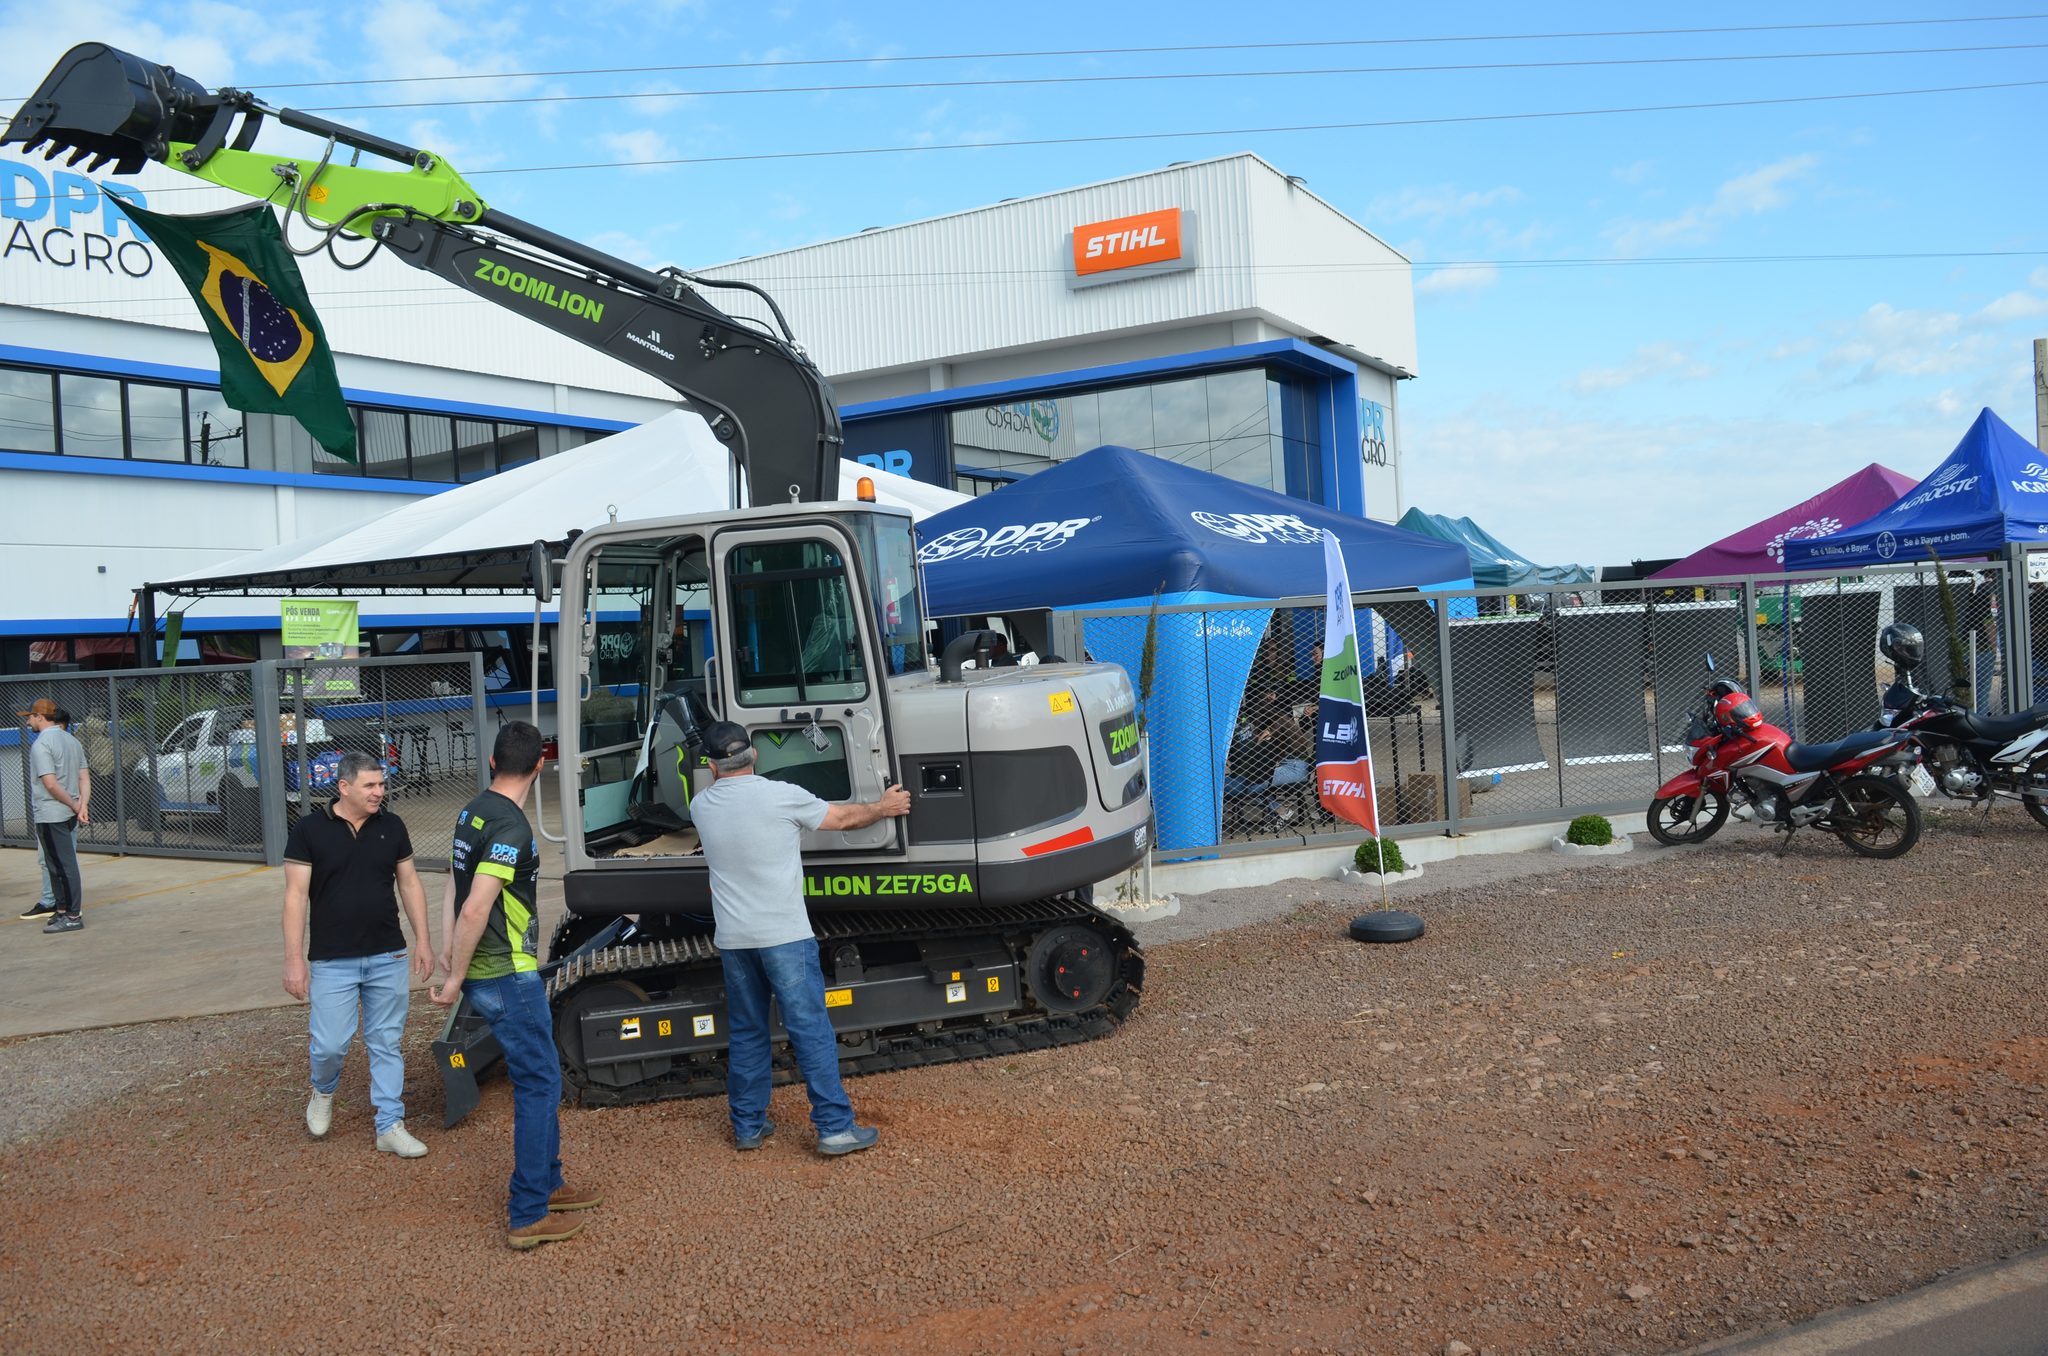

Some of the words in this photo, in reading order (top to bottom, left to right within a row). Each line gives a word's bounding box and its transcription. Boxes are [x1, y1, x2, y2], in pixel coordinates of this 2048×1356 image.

[0, 159, 152, 243] DPR
[3, 221, 153, 278] AGRO
[1086, 226, 1166, 258] STIHL
[474, 258, 604, 323] ZOOMLION
[626, 332, 675, 361] MANTOMAC
[1361, 397, 1385, 443] PR
[857, 449, 913, 479] PR
[1362, 438, 1387, 467] GRO
[981, 517, 1091, 547] DPR
[1228, 513, 1322, 533] DPR
[963, 538, 1066, 560] AGRO
[1851, 544, 1871, 554] Bayer.
[1903, 538, 1914, 547] Se
[1920, 536, 1943, 545] Bayer,
[1950, 532, 1971, 541] bom.
[286, 605, 299, 616] PÓS
[300, 607, 320, 616] VENDA
[489, 853, 517, 865] AGRO
[491, 843, 519, 858] DPR
[803, 876, 871, 896] LION
[876, 874, 973, 895] ZE75GA
